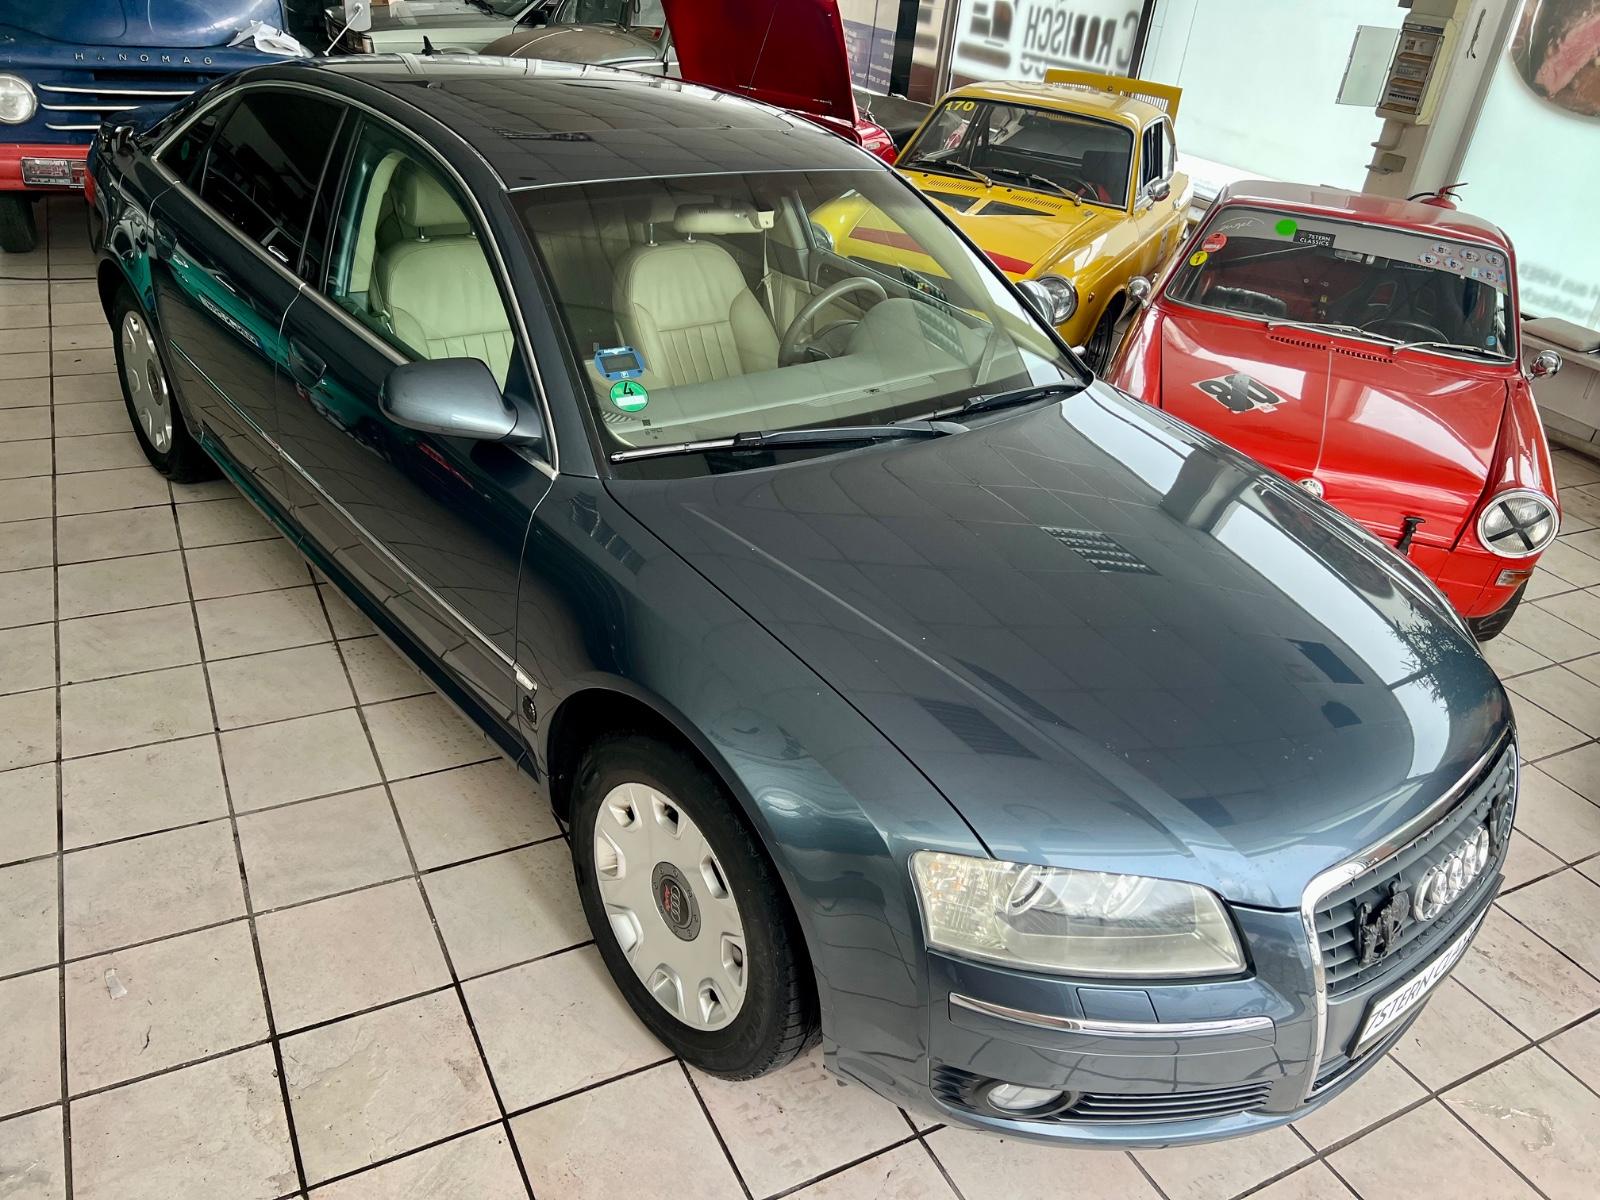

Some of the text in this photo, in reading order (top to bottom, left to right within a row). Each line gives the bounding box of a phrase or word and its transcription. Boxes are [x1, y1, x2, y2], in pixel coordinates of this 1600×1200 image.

[1299, 237, 1330, 247] CLASSICS
[1308, 233, 1331, 242] 7STERN
[623, 381, 635, 396] 4
[1364, 966, 1435, 1036] 7STERN
